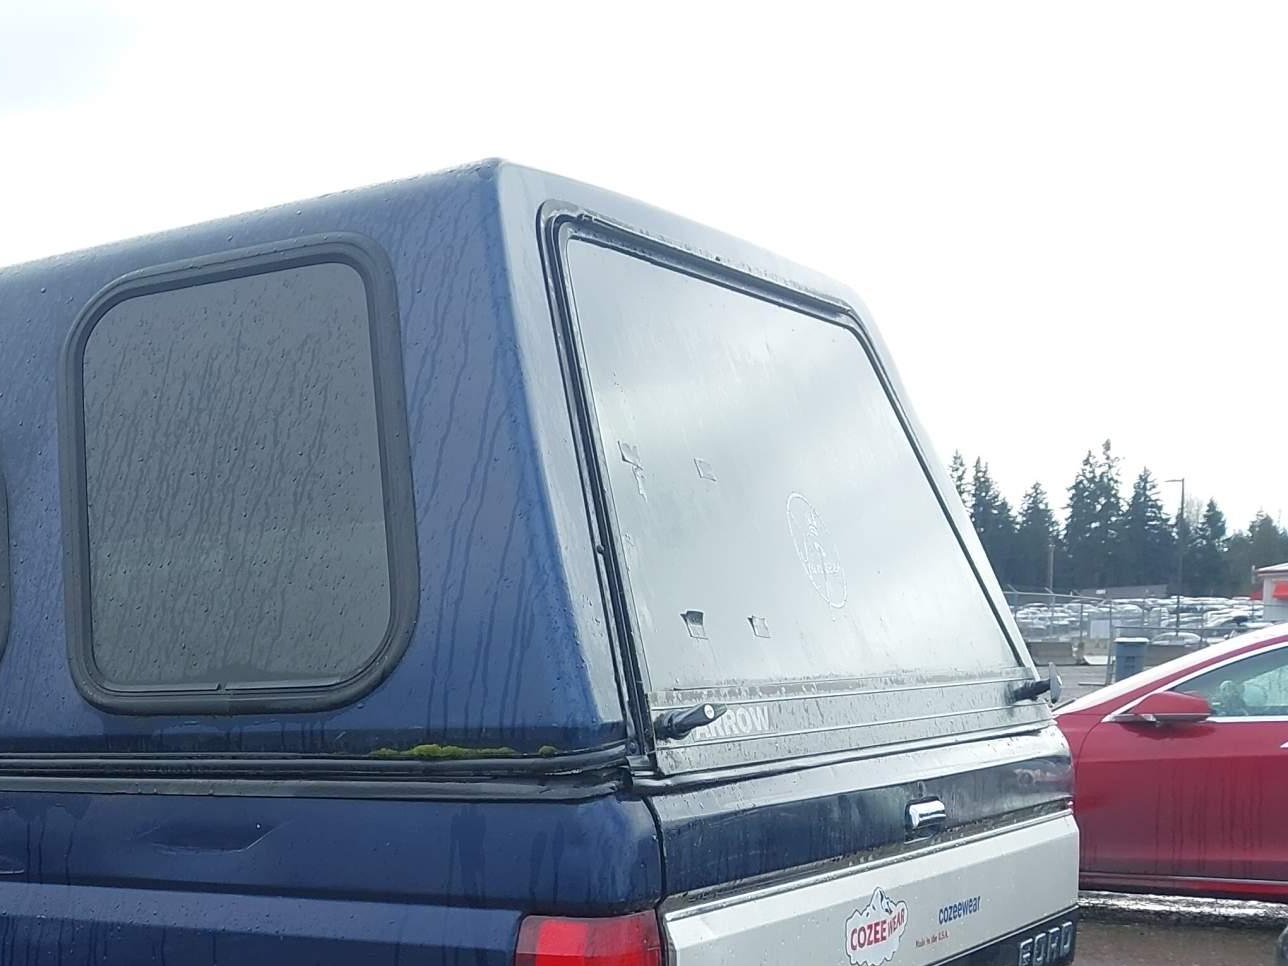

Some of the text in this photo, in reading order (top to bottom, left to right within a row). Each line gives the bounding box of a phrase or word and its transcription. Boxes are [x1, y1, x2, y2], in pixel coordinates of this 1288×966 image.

[938, 896, 980, 925] cozeewear
[850, 908, 905, 951] COZEE WEAR
